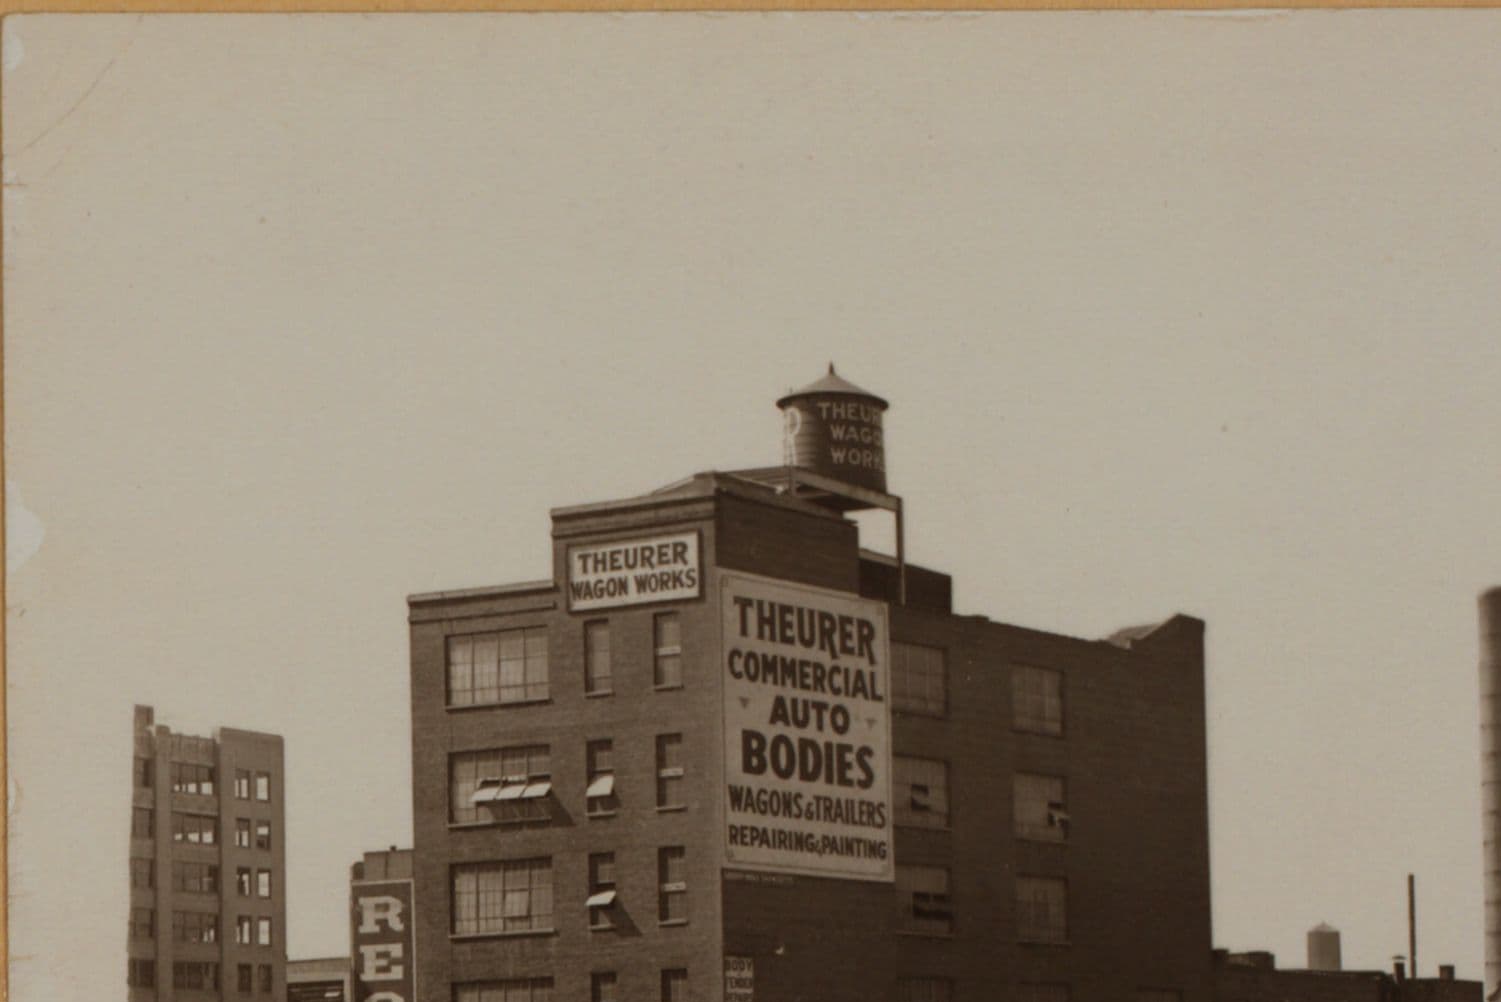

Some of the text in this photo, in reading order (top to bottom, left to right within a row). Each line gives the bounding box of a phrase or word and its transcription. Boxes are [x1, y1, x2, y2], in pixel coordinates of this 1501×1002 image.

[817, 401, 882, 424] THEUR
[577, 541, 688, 575] THEURER
[570, 566, 697, 602] WAGON WORKS
[733, 595, 877, 665] THEURER
[728, 647, 884, 703] COMMERCIAL
[768, 694, 850, 735] AUTO
[741, 731, 875, 790] BODIES
[728, 784, 804, 818] WAGONS
[812, 796, 887, 829] TRAILERS
[728, 824, 817, 854] REPAIRING
[821, 836, 888, 861] PAINTING
